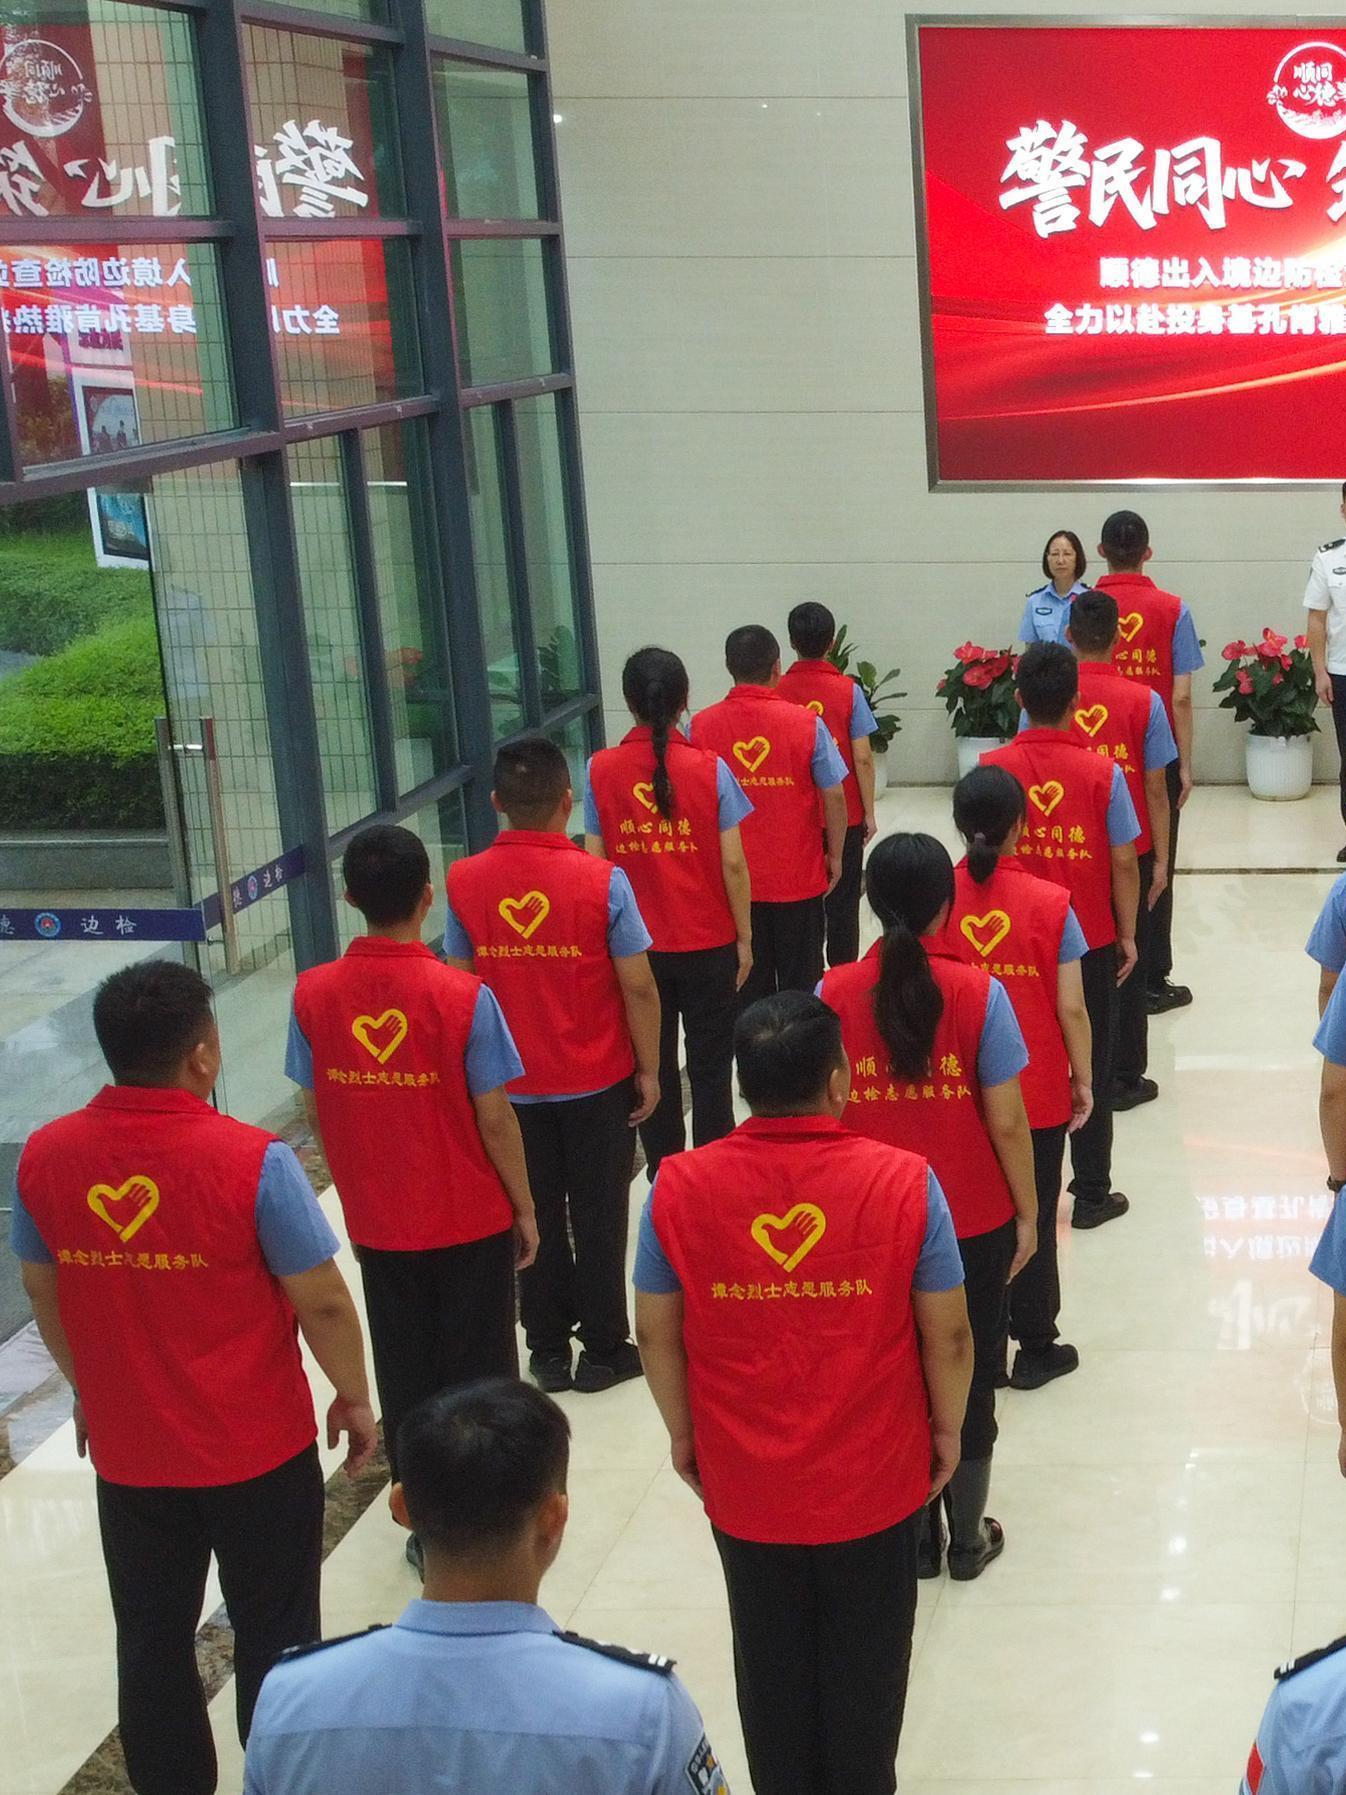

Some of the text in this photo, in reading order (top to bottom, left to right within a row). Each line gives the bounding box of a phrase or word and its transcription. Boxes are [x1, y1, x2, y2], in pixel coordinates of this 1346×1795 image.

[1000, 120, 1306, 238] 警民同心
[80, 914, 137, 936] 边检
